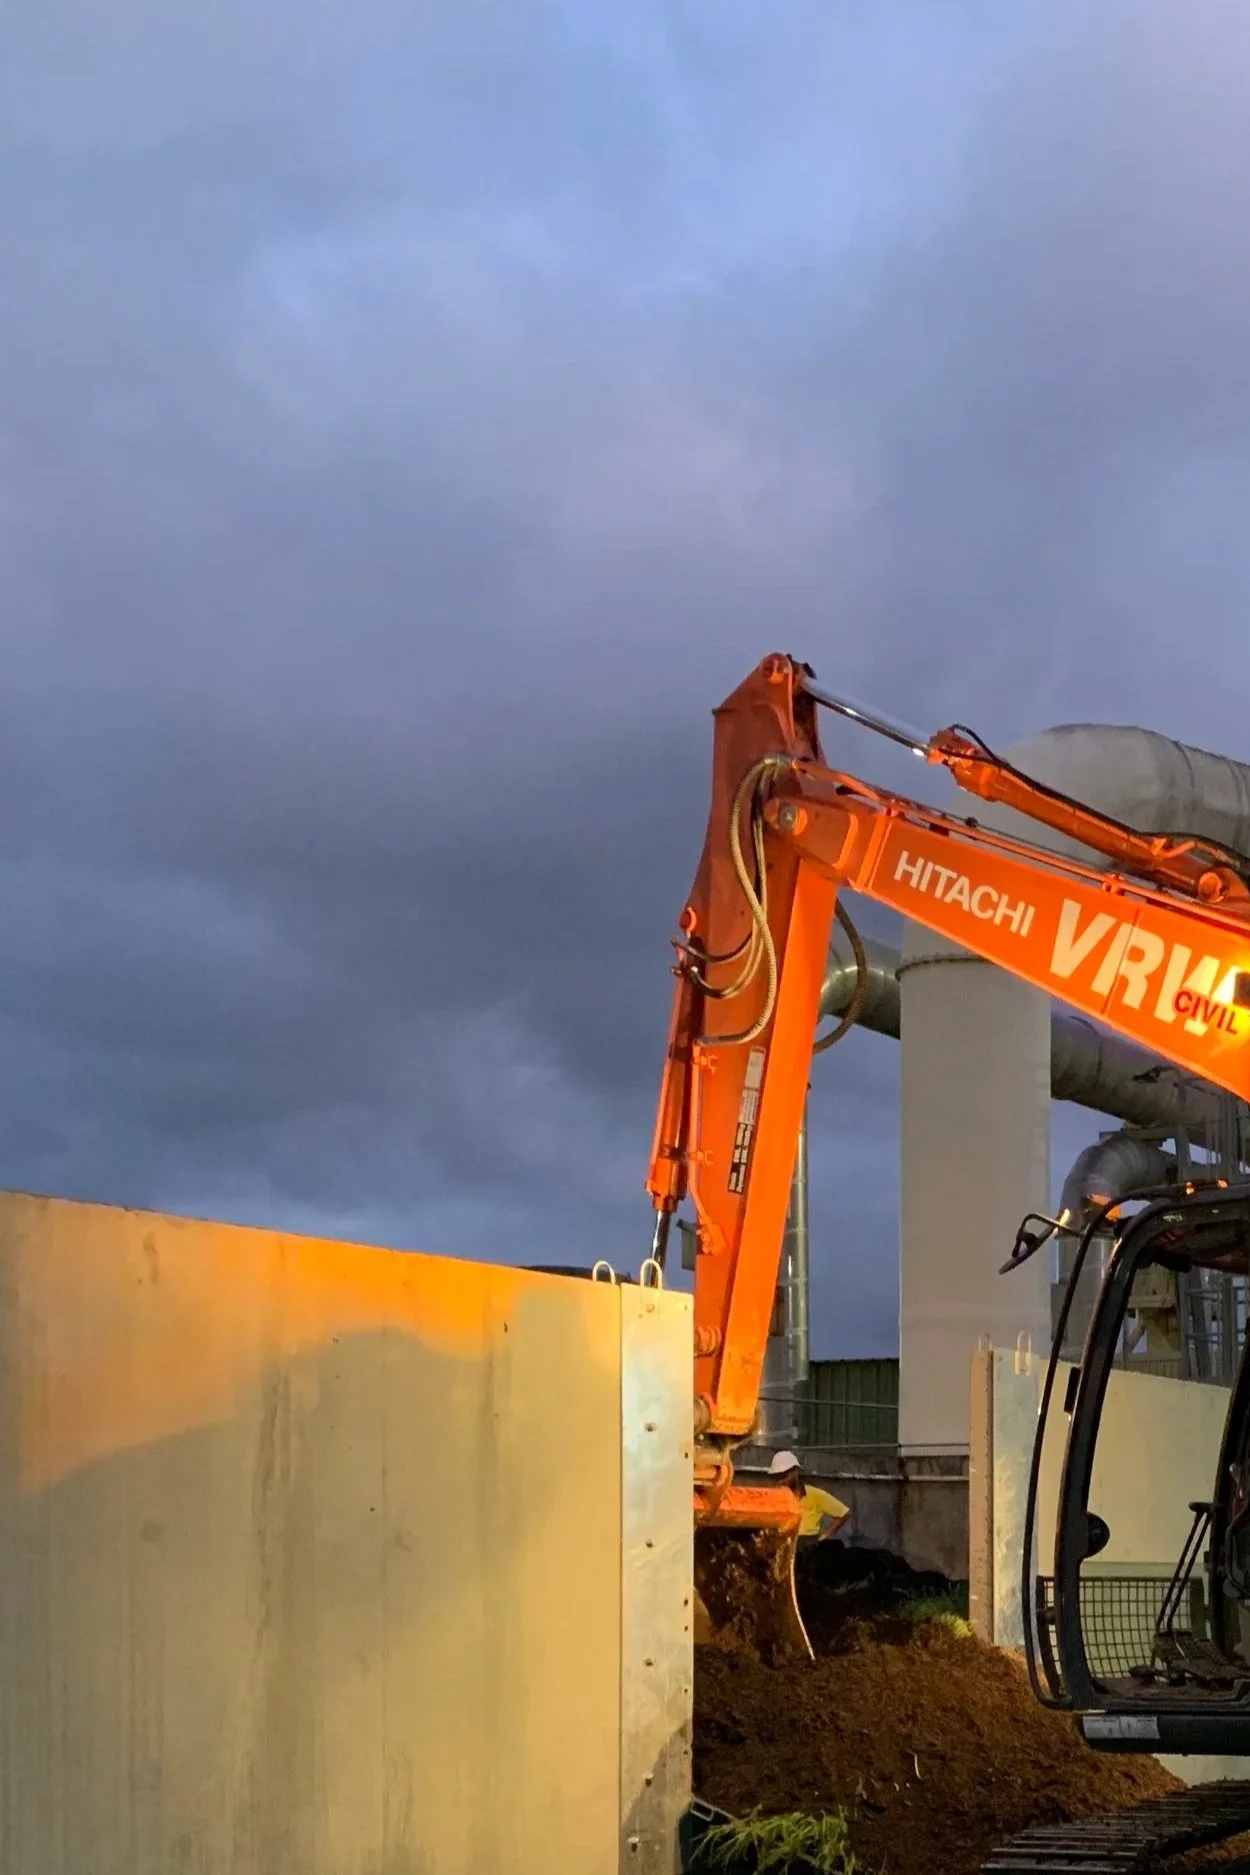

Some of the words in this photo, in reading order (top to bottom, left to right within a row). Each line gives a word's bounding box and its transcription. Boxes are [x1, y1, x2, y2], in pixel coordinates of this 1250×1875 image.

[893, 849, 1036, 938] HITACHI
[1050, 897, 1236, 1037] VRW
[1174, 990, 1238, 1035] CIVIL
